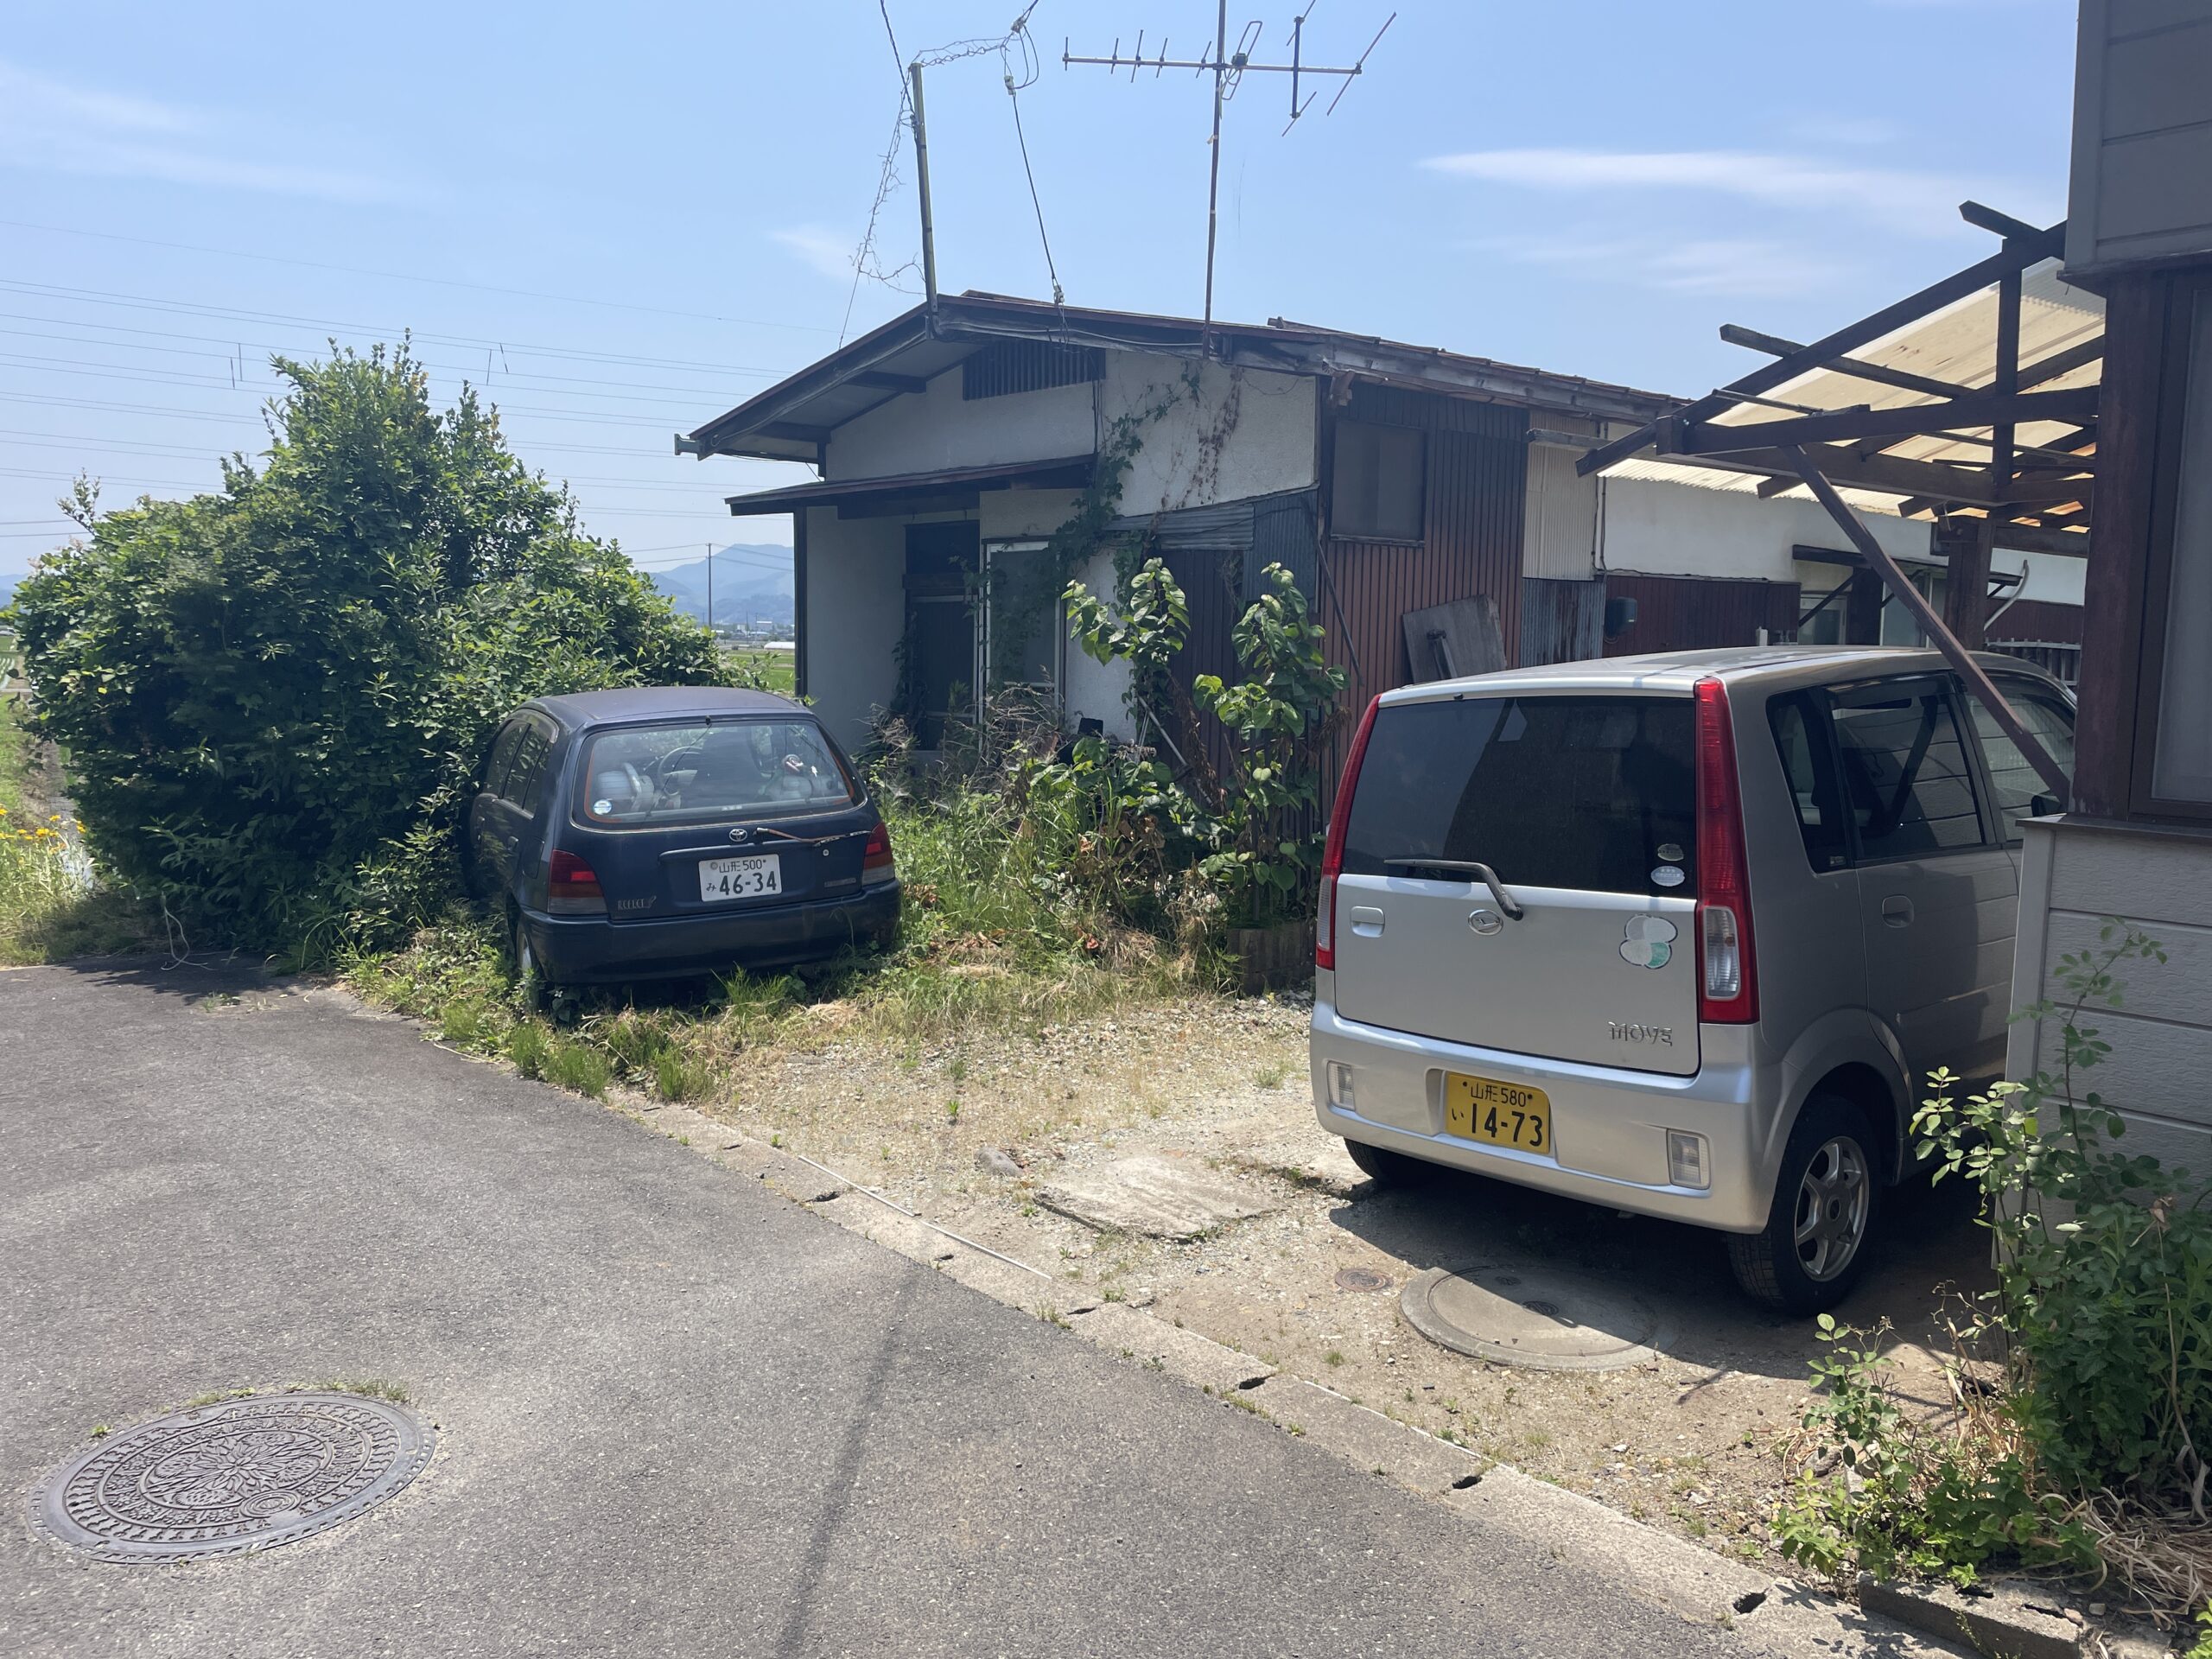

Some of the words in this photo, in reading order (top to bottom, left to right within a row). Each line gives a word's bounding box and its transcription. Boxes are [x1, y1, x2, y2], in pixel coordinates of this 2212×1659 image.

[719, 870, 777, 895] 46-34
[1452, 1108, 1465, 1122] い
[1471, 1103, 1542, 1147] 14-73
